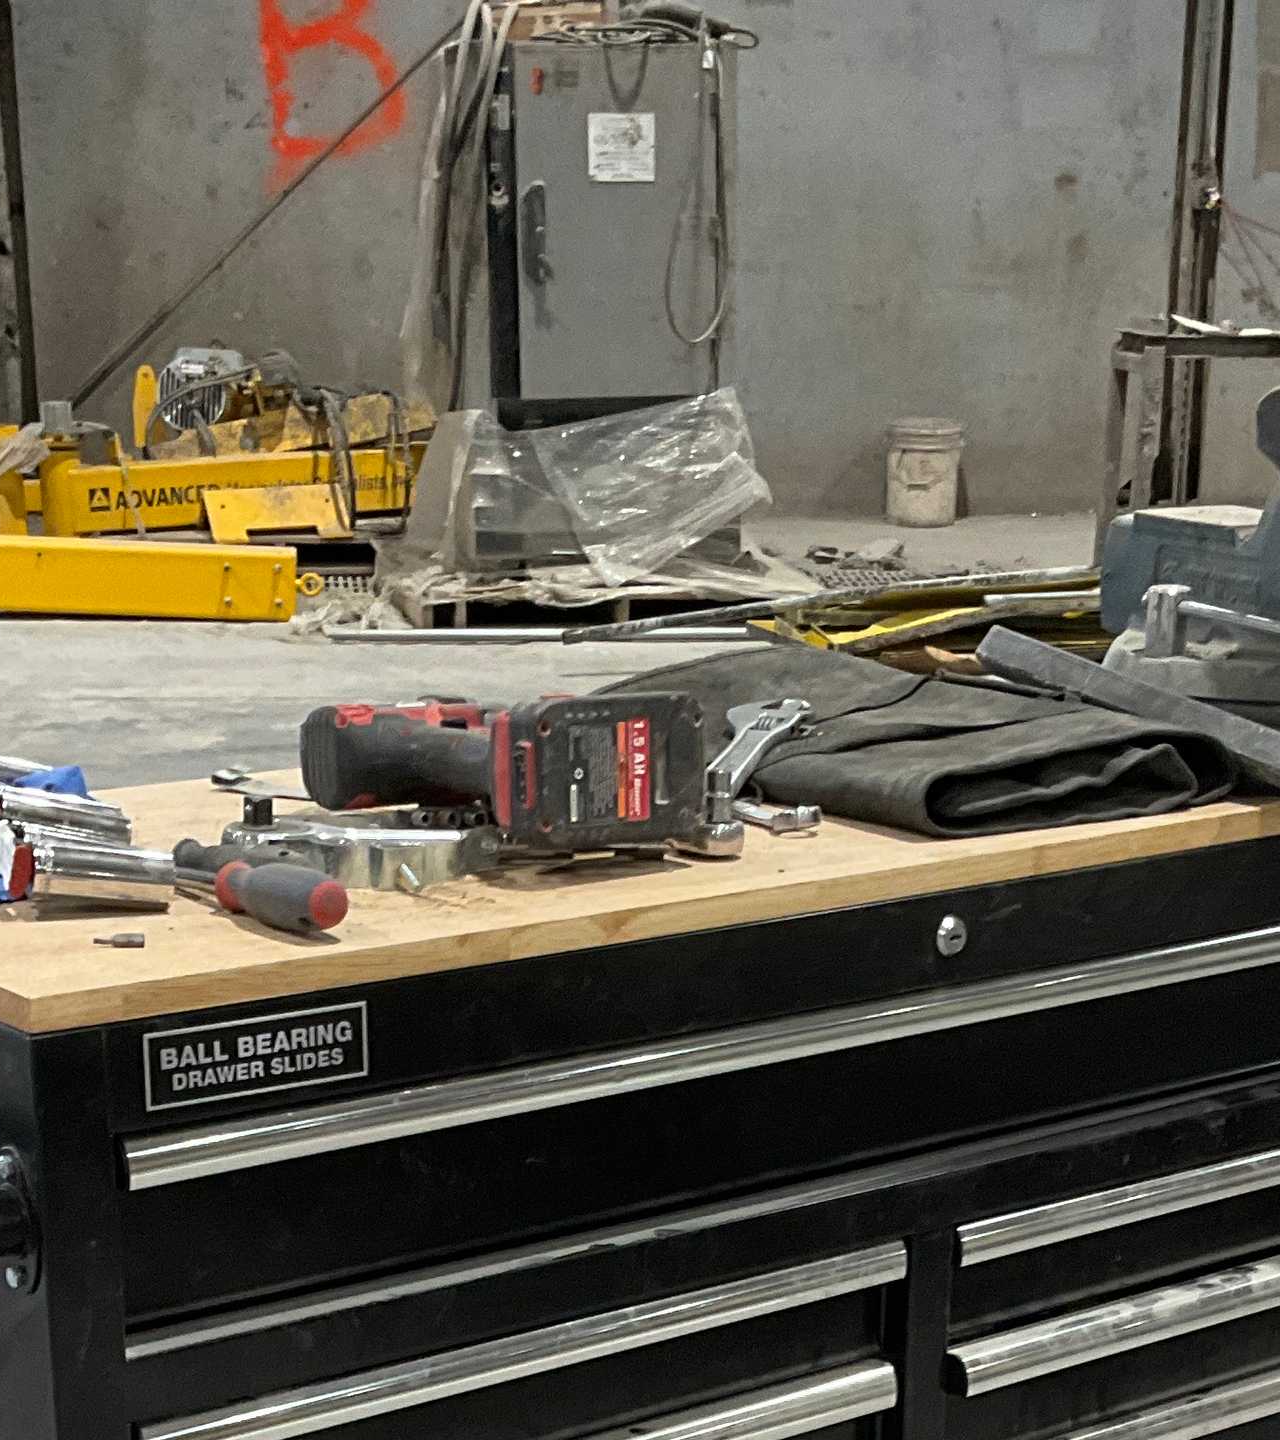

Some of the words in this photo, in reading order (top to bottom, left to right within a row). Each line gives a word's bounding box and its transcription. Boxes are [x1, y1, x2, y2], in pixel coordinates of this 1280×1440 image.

[633, 720, 646, 748] 1.5
[159, 1039, 230, 1071] BALL
[237, 1020, 354, 1059] BEARING
[172, 1060, 265, 1092] DRAWER
[270, 1047, 345, 1076] SLIDES
